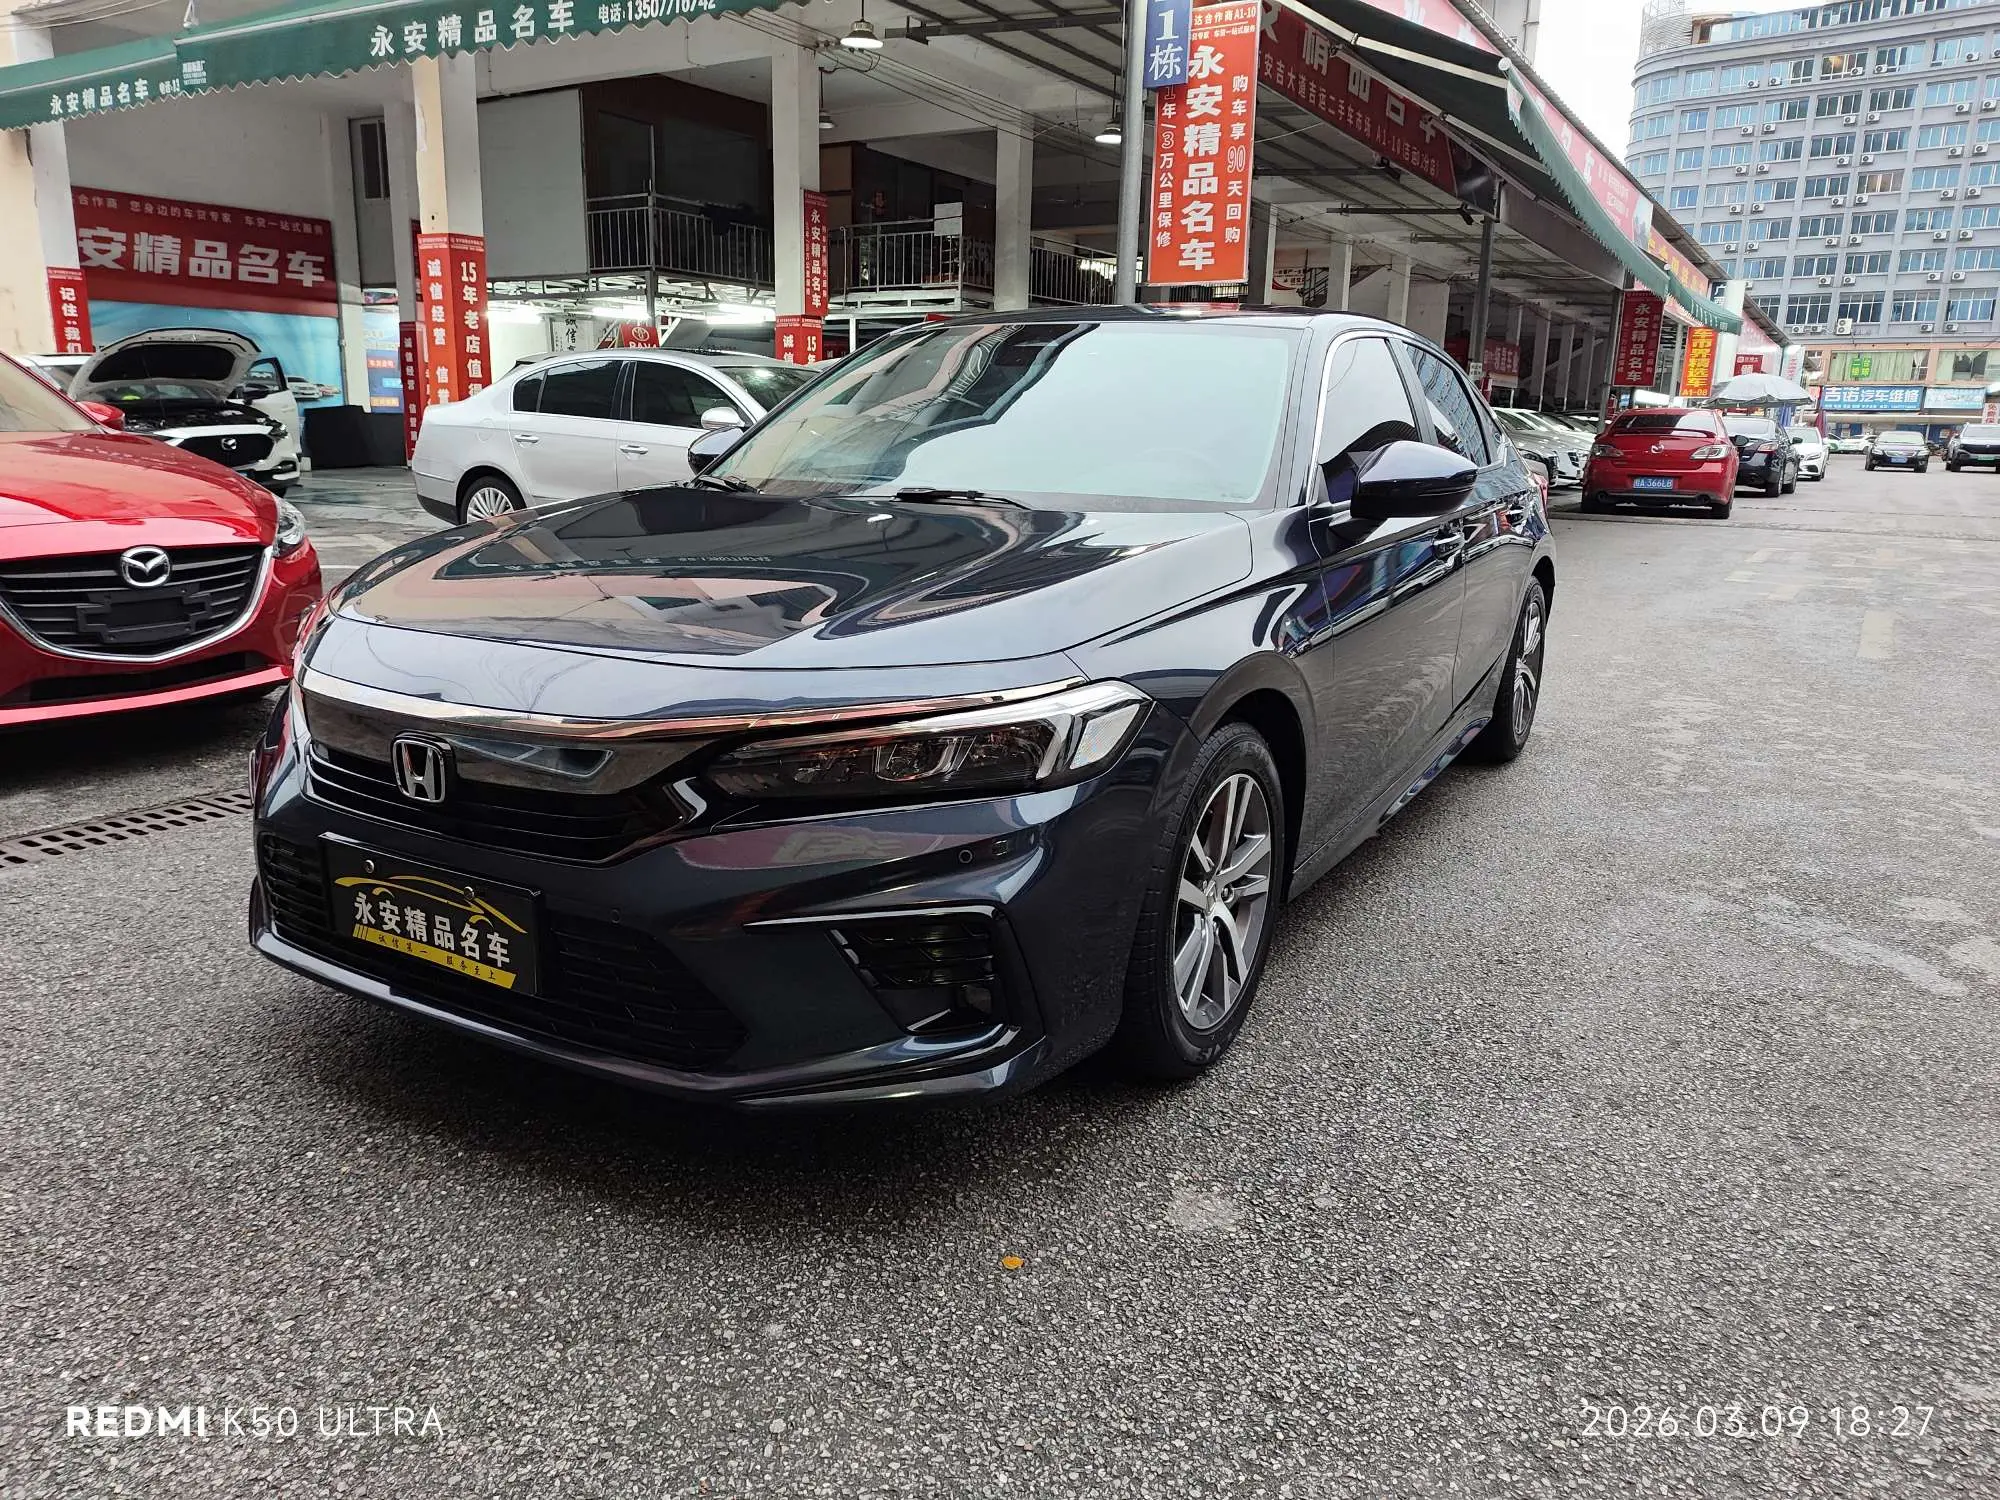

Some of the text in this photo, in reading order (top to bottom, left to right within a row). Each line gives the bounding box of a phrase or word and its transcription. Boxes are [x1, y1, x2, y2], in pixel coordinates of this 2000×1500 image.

[369, 0, 575, 57] 永安精品名车
[50, 78, 149, 115] 永安精品名车
[1178, 45, 1225, 272] 永安精品名车
[1225, 74, 1249, 244] 购车享90天回购
[78, 226, 325, 288] 安精品名车
[811, 208, 822, 309] 永安精品名车
[427, 258, 446, 346] 诚信经营
[1626, 303, 1650, 382] 永安精品名车
[1824, 386, 1920, 404] 吉诺汽车维修
[353, 891, 511, 969] 永安精品名车
